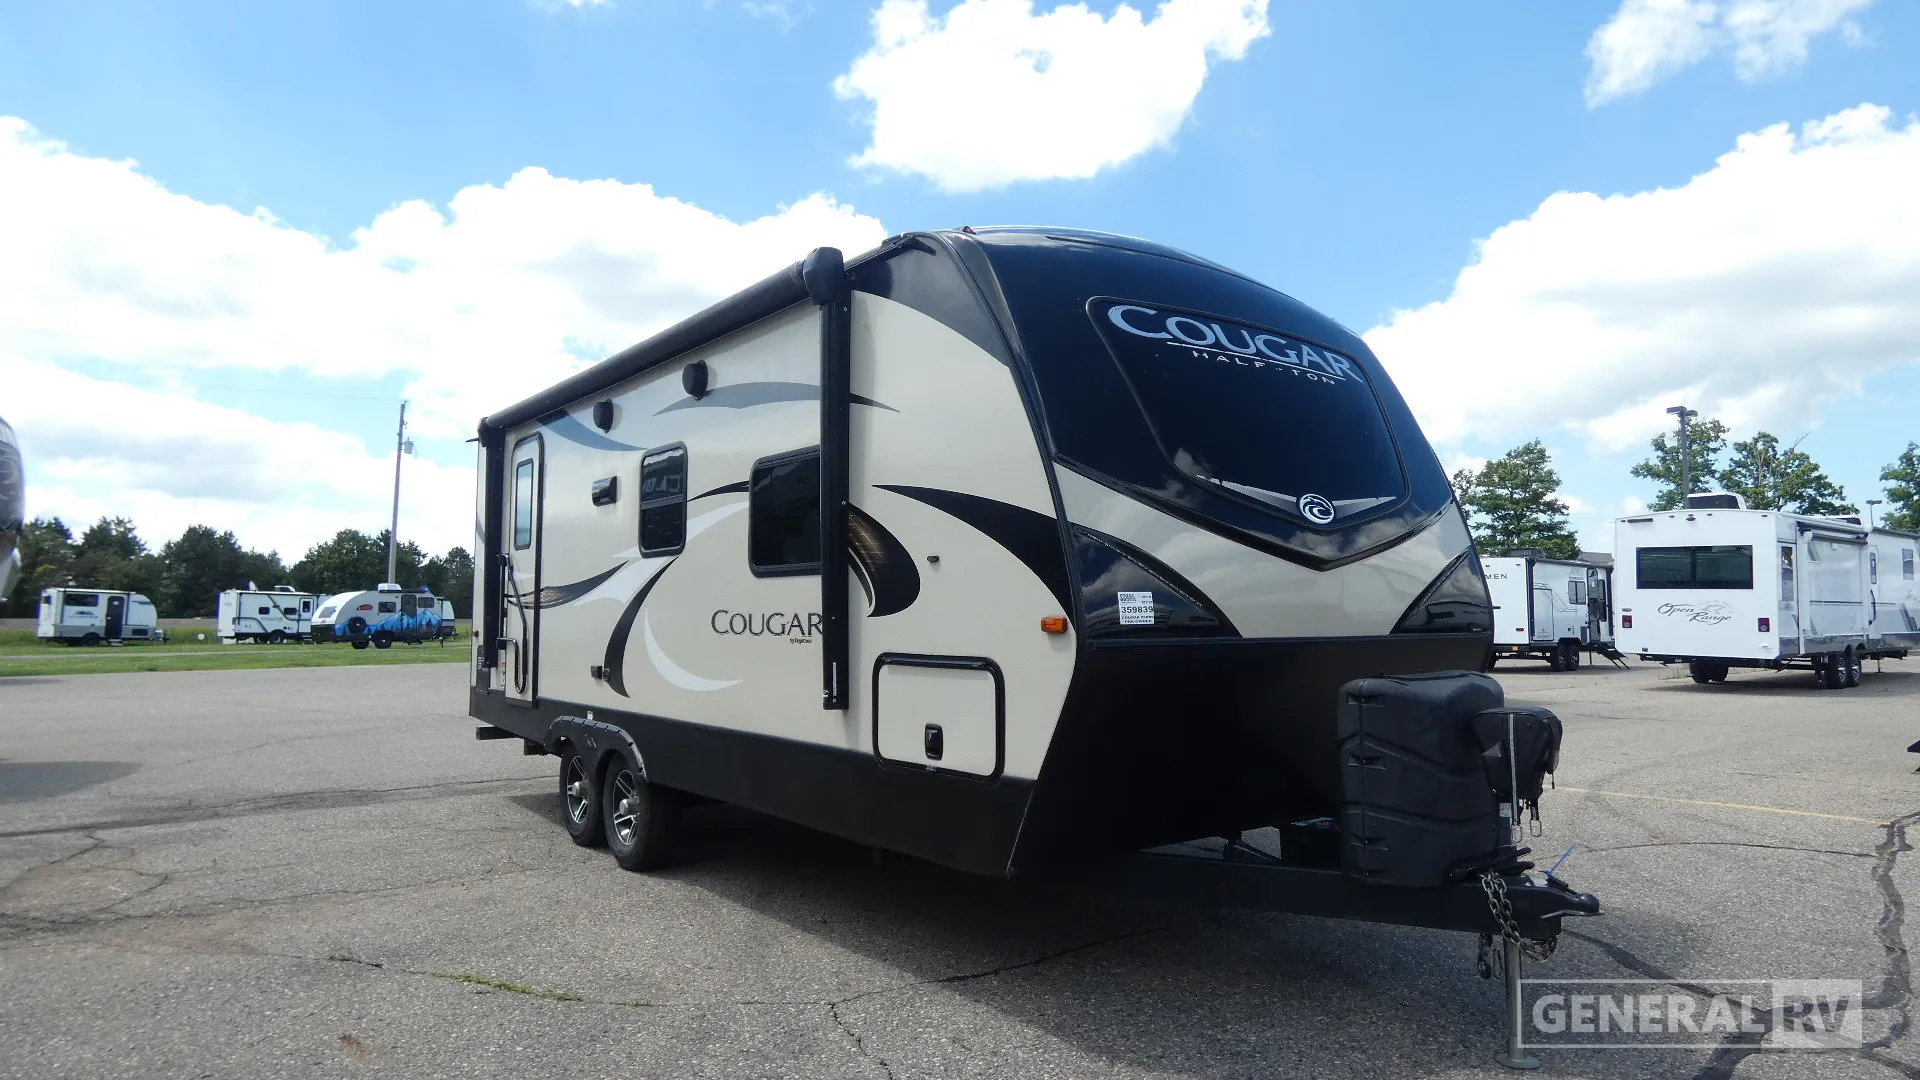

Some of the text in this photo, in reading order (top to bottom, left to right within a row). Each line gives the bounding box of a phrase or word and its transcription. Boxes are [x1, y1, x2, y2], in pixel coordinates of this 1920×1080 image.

[1108, 305, 1364, 383] COUGAR
[1657, 602, 1695, 617] Open
[1687, 611, 1732, 626] Range
[711, 609, 823, 636] COUGAR
